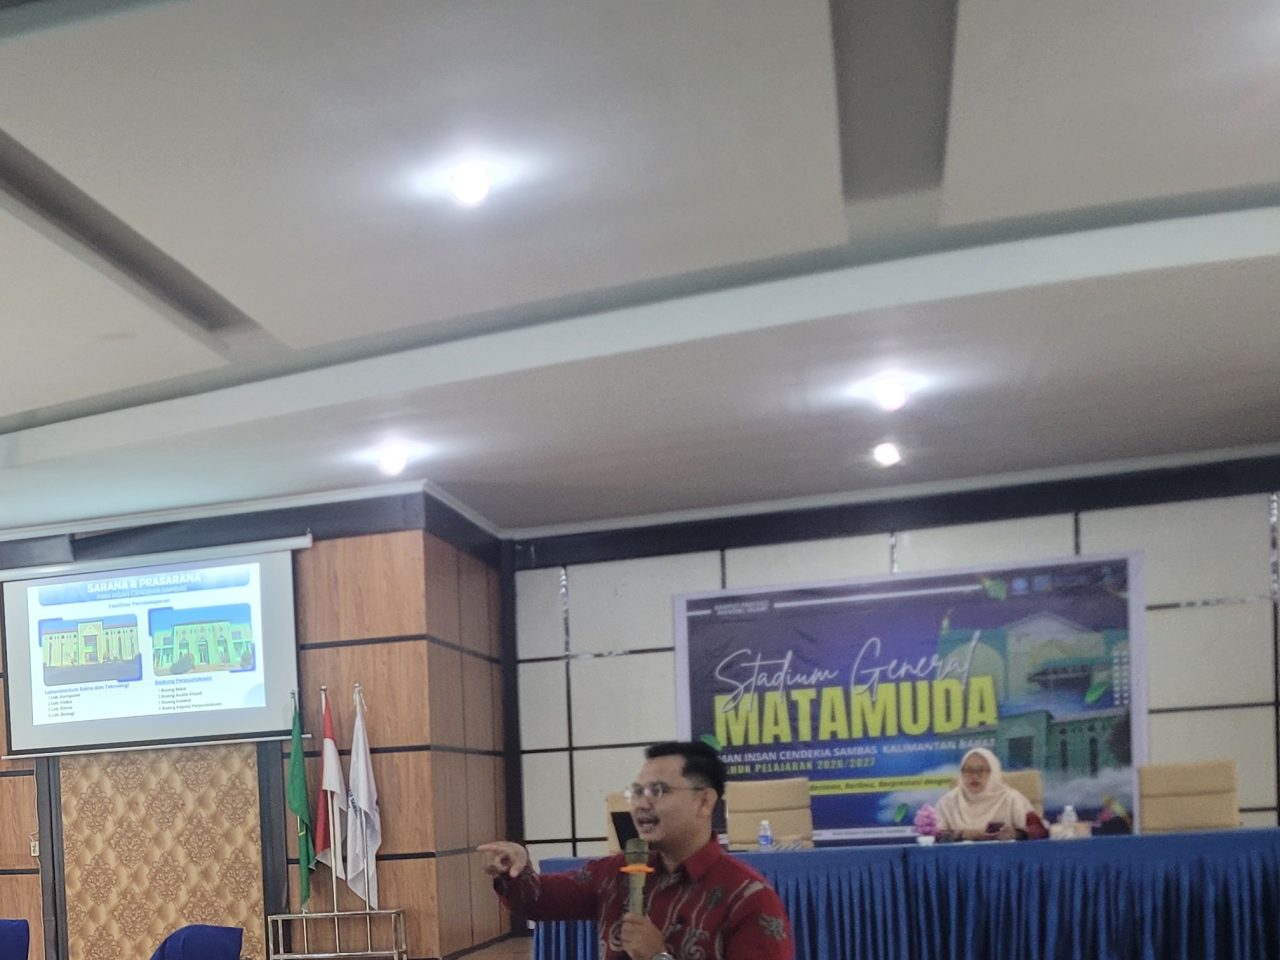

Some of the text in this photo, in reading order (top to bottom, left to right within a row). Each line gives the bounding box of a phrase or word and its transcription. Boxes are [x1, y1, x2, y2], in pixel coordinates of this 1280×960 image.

[87, 581, 128, 593] SARANA
[138, 573, 202, 588] PRASARANA
[714, 630, 982, 714] Stadium General
[714, 675, 998, 747] MATAMUDA
[719, 753, 742, 764] MAN
[743, 751, 777, 763] INSAN
[778, 748, 832, 761] CENDEKIA
[833, 745, 878, 757] SAMBAS
[882, 740, 957, 754] KALIMANTAN
[755, 760, 813, 773] PELAJARAN
